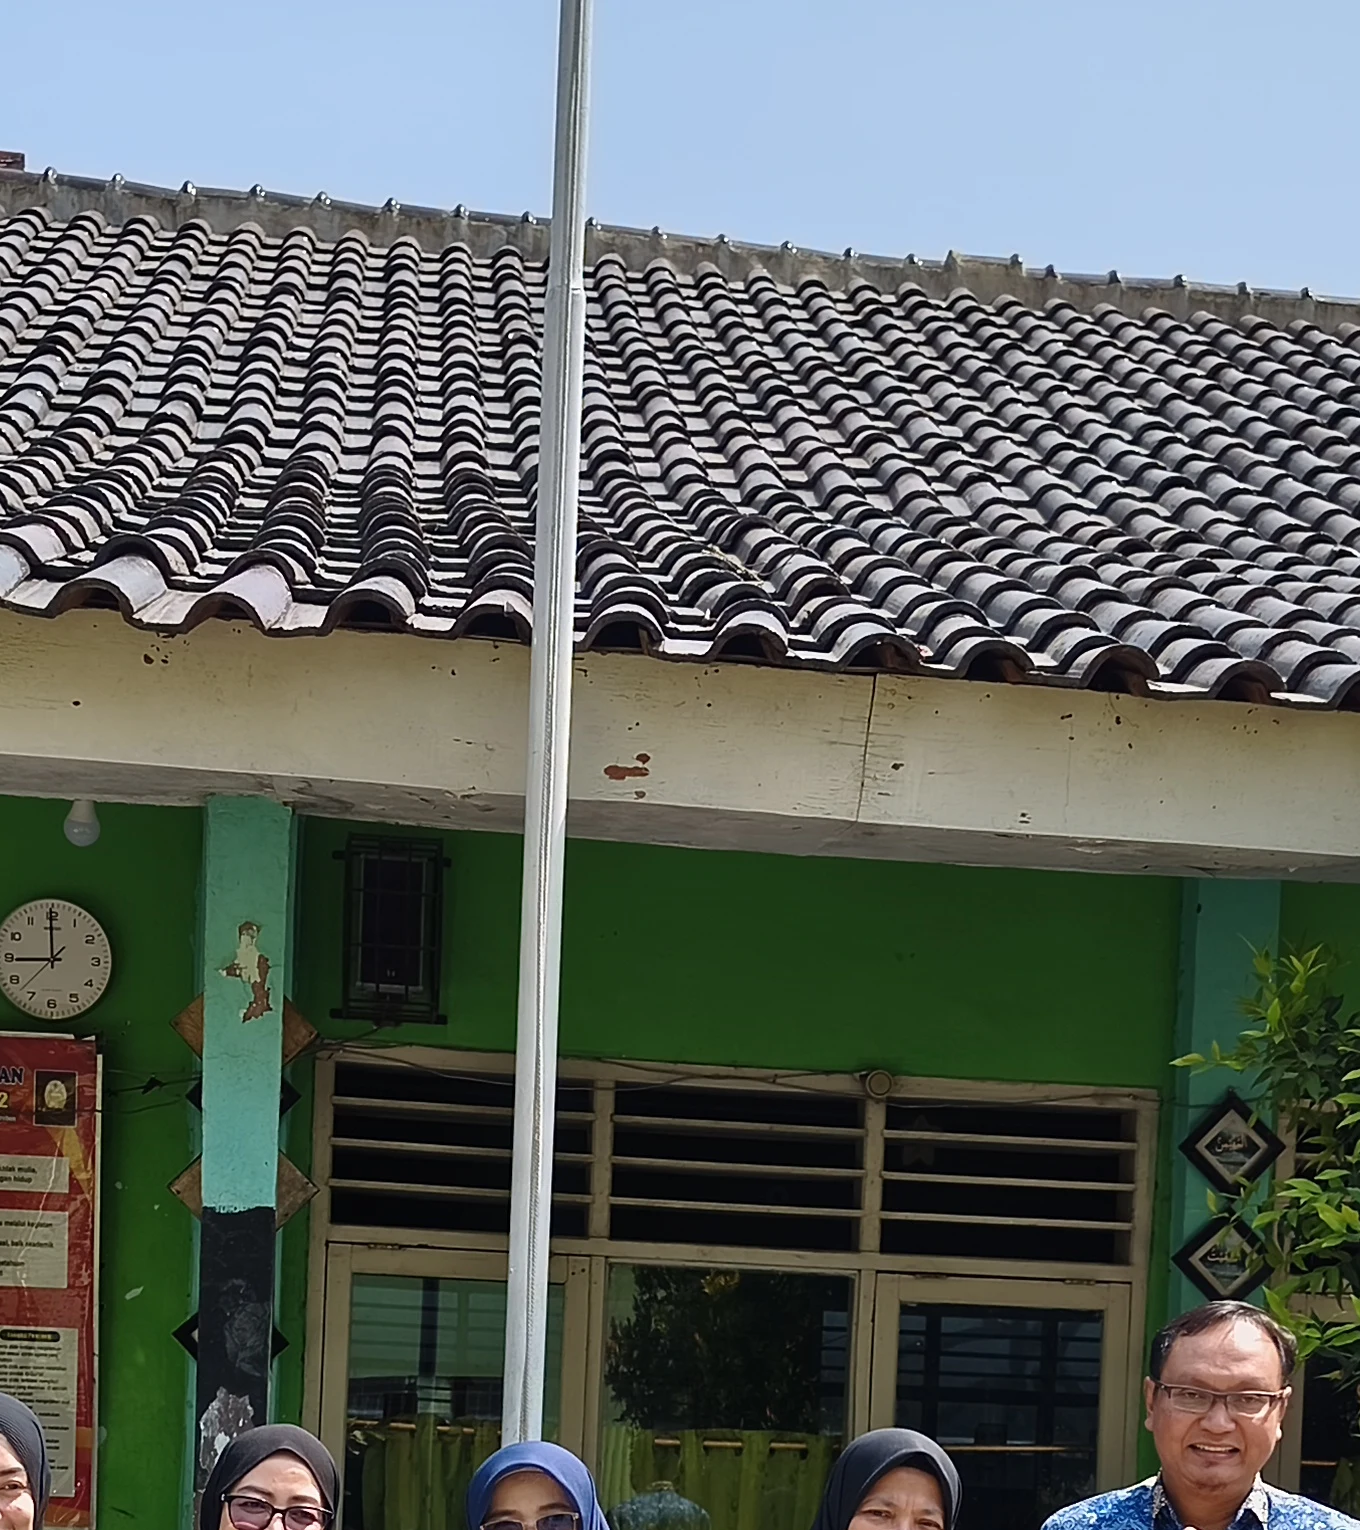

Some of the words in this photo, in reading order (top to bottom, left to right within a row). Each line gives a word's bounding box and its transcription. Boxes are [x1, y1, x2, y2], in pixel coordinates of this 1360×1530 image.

[27, 916, 34, 926] 11
[10, 932, 22, 942] 10
[84, 934, 95, 944] 2
[4, 952, 14, 963] 9
[90, 956, 101, 967] 3
[9, 974, 20, 985] 8
[84, 978, 94, 988] 4
[26, 991, 36, 1001] 7
[68, 993, 79, 1003] 5
[46, 998, 57, 1009] 6
